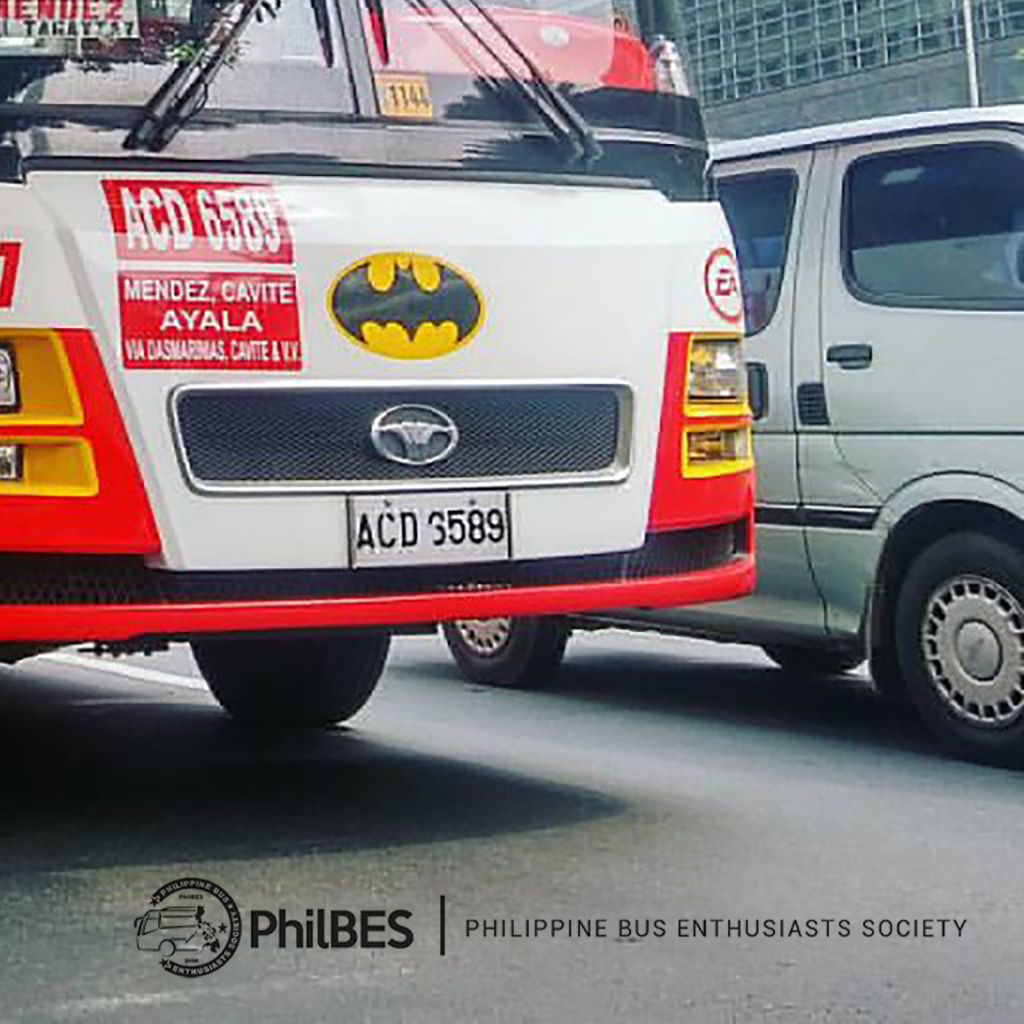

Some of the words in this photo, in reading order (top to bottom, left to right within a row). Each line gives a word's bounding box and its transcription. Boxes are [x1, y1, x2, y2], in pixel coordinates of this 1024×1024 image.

[120, 186, 193, 251] ACD
[196, 188, 282, 253] 6589
[220, 280, 294, 304] CAVITE
[160, 310, 264, 332] AYALA
[126, 338, 146, 361] VIA
[231, 339, 269, 362] CAVITE
[357, 511, 418, 549] ACD
